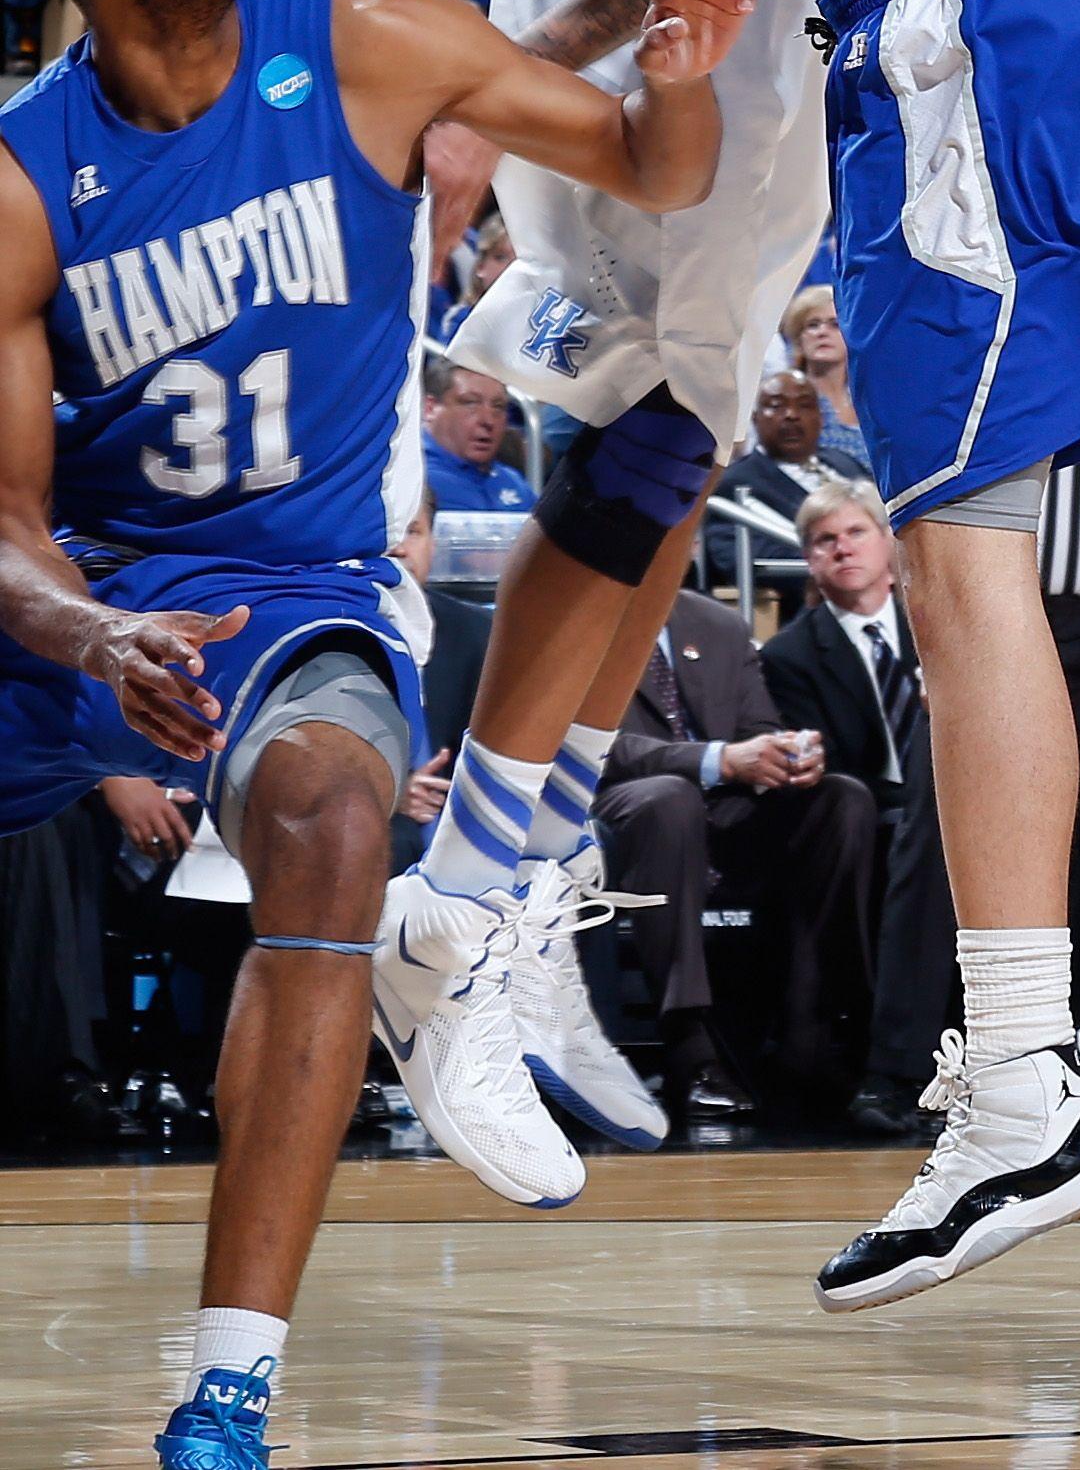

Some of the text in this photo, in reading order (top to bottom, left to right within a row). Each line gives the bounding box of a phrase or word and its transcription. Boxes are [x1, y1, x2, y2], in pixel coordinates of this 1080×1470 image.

[266, 70, 313, 102] NCAA
[63, 174, 350, 388] HAMPTON
[520, 286, 590, 380] UK
[139, 348, 302, 499] 31
